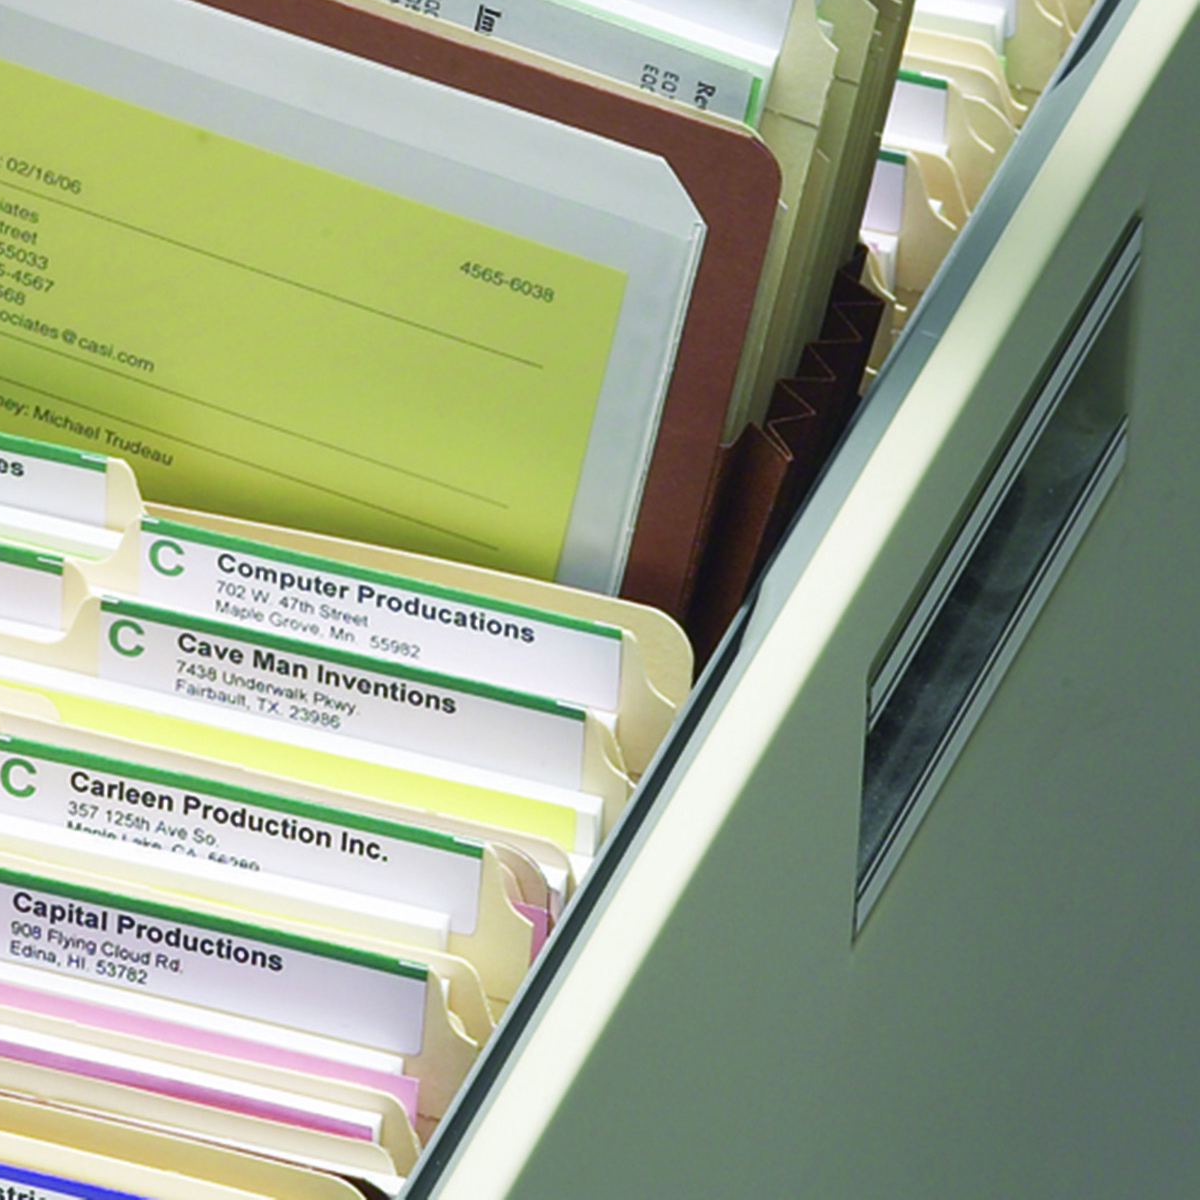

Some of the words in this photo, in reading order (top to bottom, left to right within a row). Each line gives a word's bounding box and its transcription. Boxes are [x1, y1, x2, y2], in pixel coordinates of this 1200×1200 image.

[6, 157, 82, 195] 02/16/06
[460, 261, 554, 303] 4565-6038
[32, 405, 100, 441] Michael
[104, 430, 173, 466] Trudeau
[216, 554, 350, 599] Computer
[357, 586, 534, 644] Producations
[108, 620, 145, 658] C
[177, 633, 244, 666] Cave
[252, 649, 308, 680] Man
[317, 663, 457, 715] Inventions
[70, 771, 175, 812] Carleen
[182, 794, 331, 848] Production
[341, 829, 388, 863] Inc.
[10, 920, 43, 940] 908
[47, 928, 97, 955] Flying
[101, 938, 153, 967] Cloud
[156, 950, 184, 975] Rd.
[13, 892, 108, 932] Capital
[115, 915, 283, 972] Productions
[9, 939, 62, 969] Edina,
[67, 954, 90, 971] HI.
[95, 959, 147, 985] 53782
